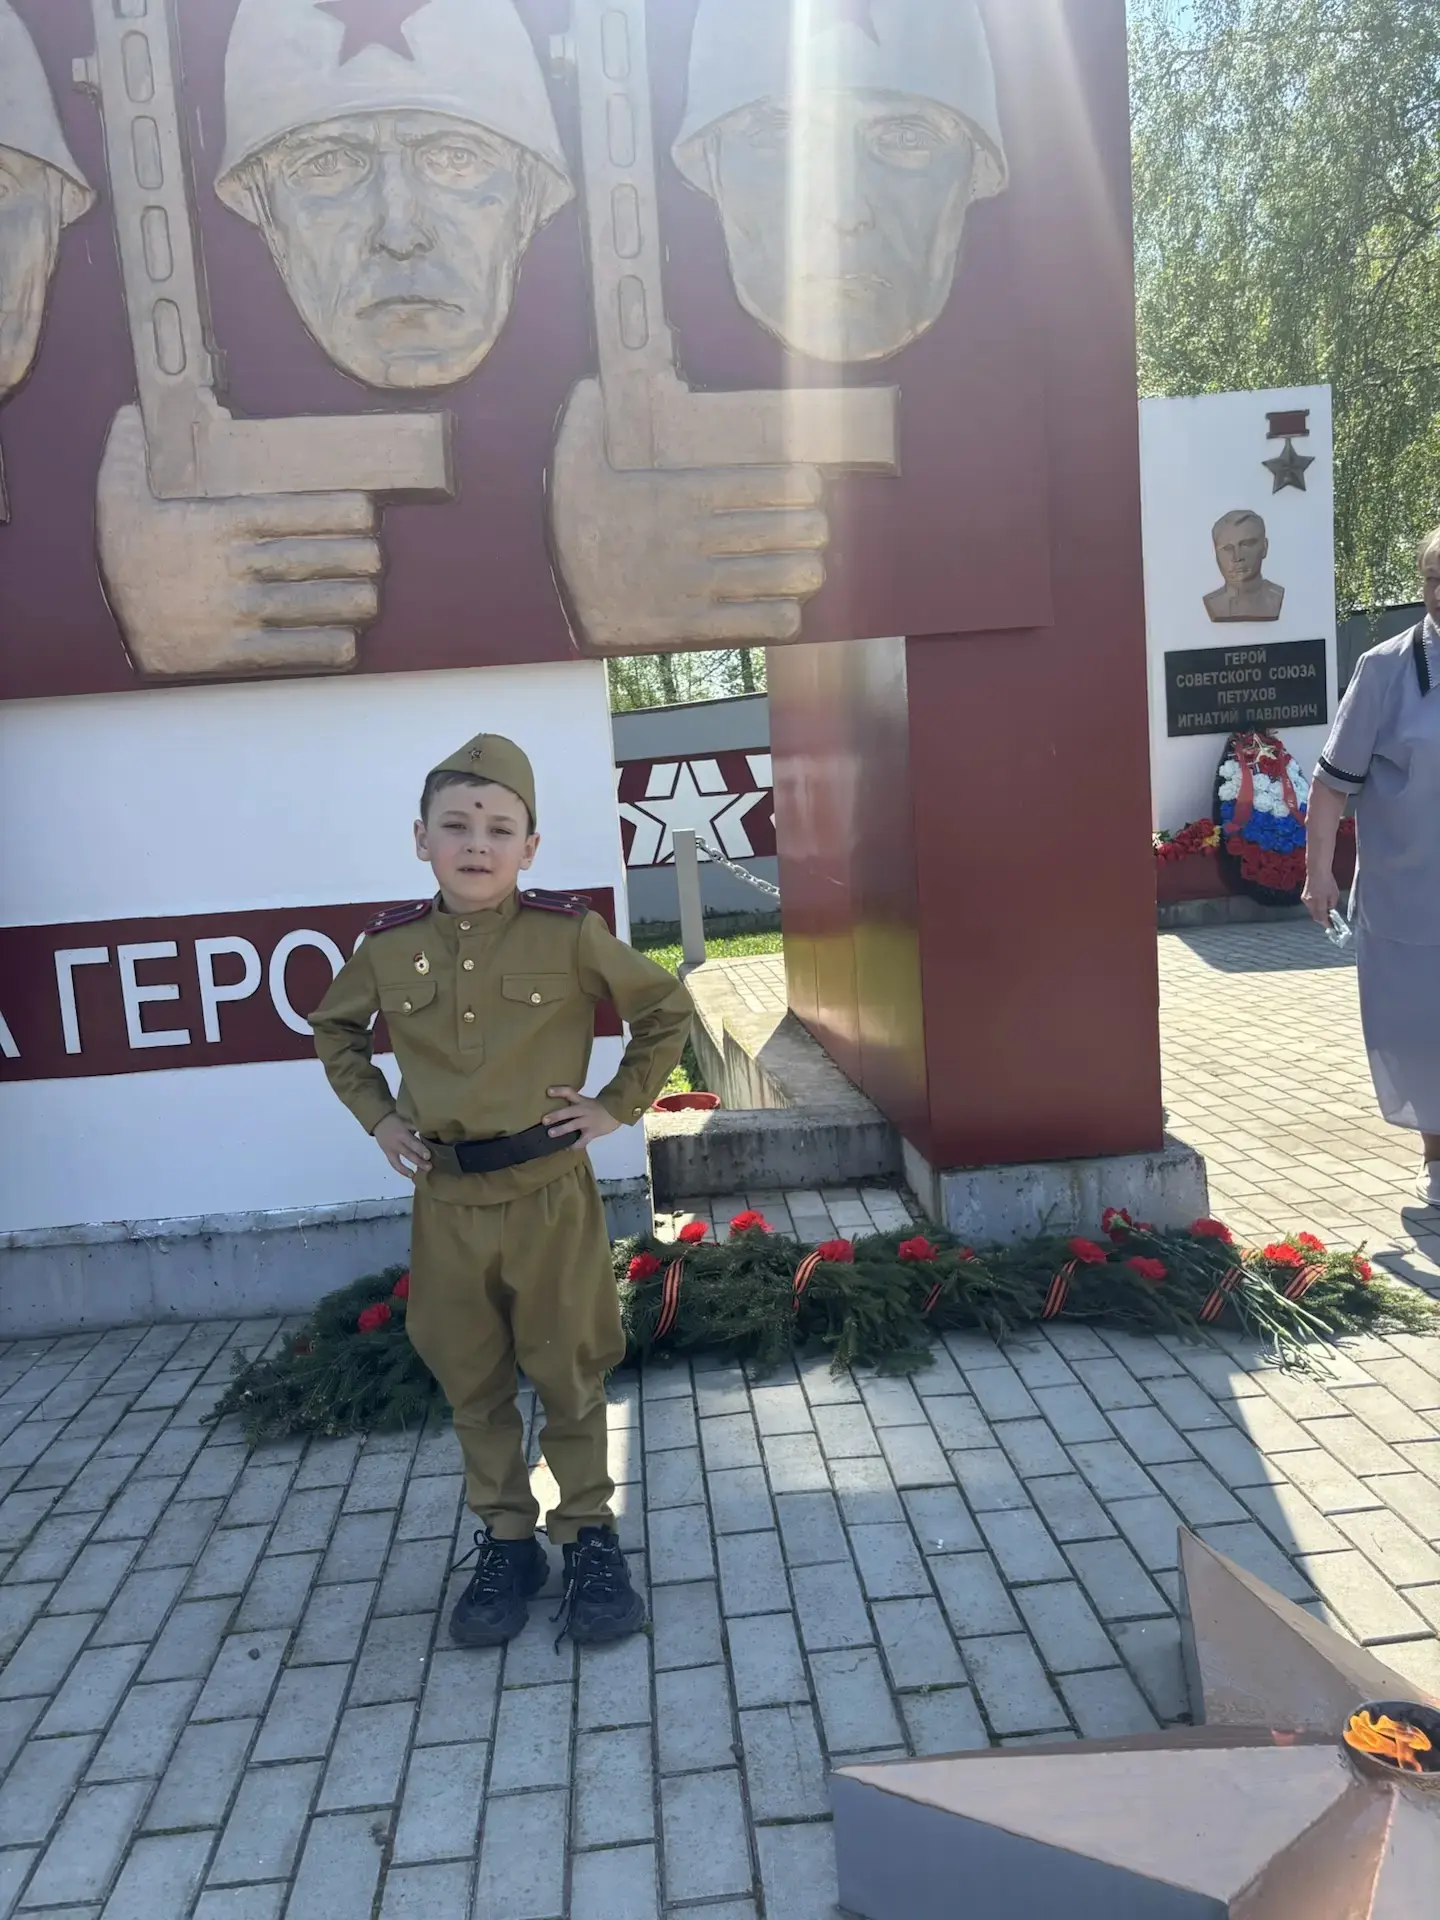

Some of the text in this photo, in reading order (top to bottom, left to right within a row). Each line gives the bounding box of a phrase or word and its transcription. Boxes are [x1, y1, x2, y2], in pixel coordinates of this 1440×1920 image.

[1224, 648, 1267, 666] ГЕРОЙ
[1176, 664, 1316, 688] СОВЕТСКОГО СОЮЗА
[1217, 687, 1277, 705] ПЕТУХОВ
[1178, 704, 1318, 728] ИГНАТИЙ ПАВЛОВИЧ
[54, 928, 379, 1055] ГЕРО
